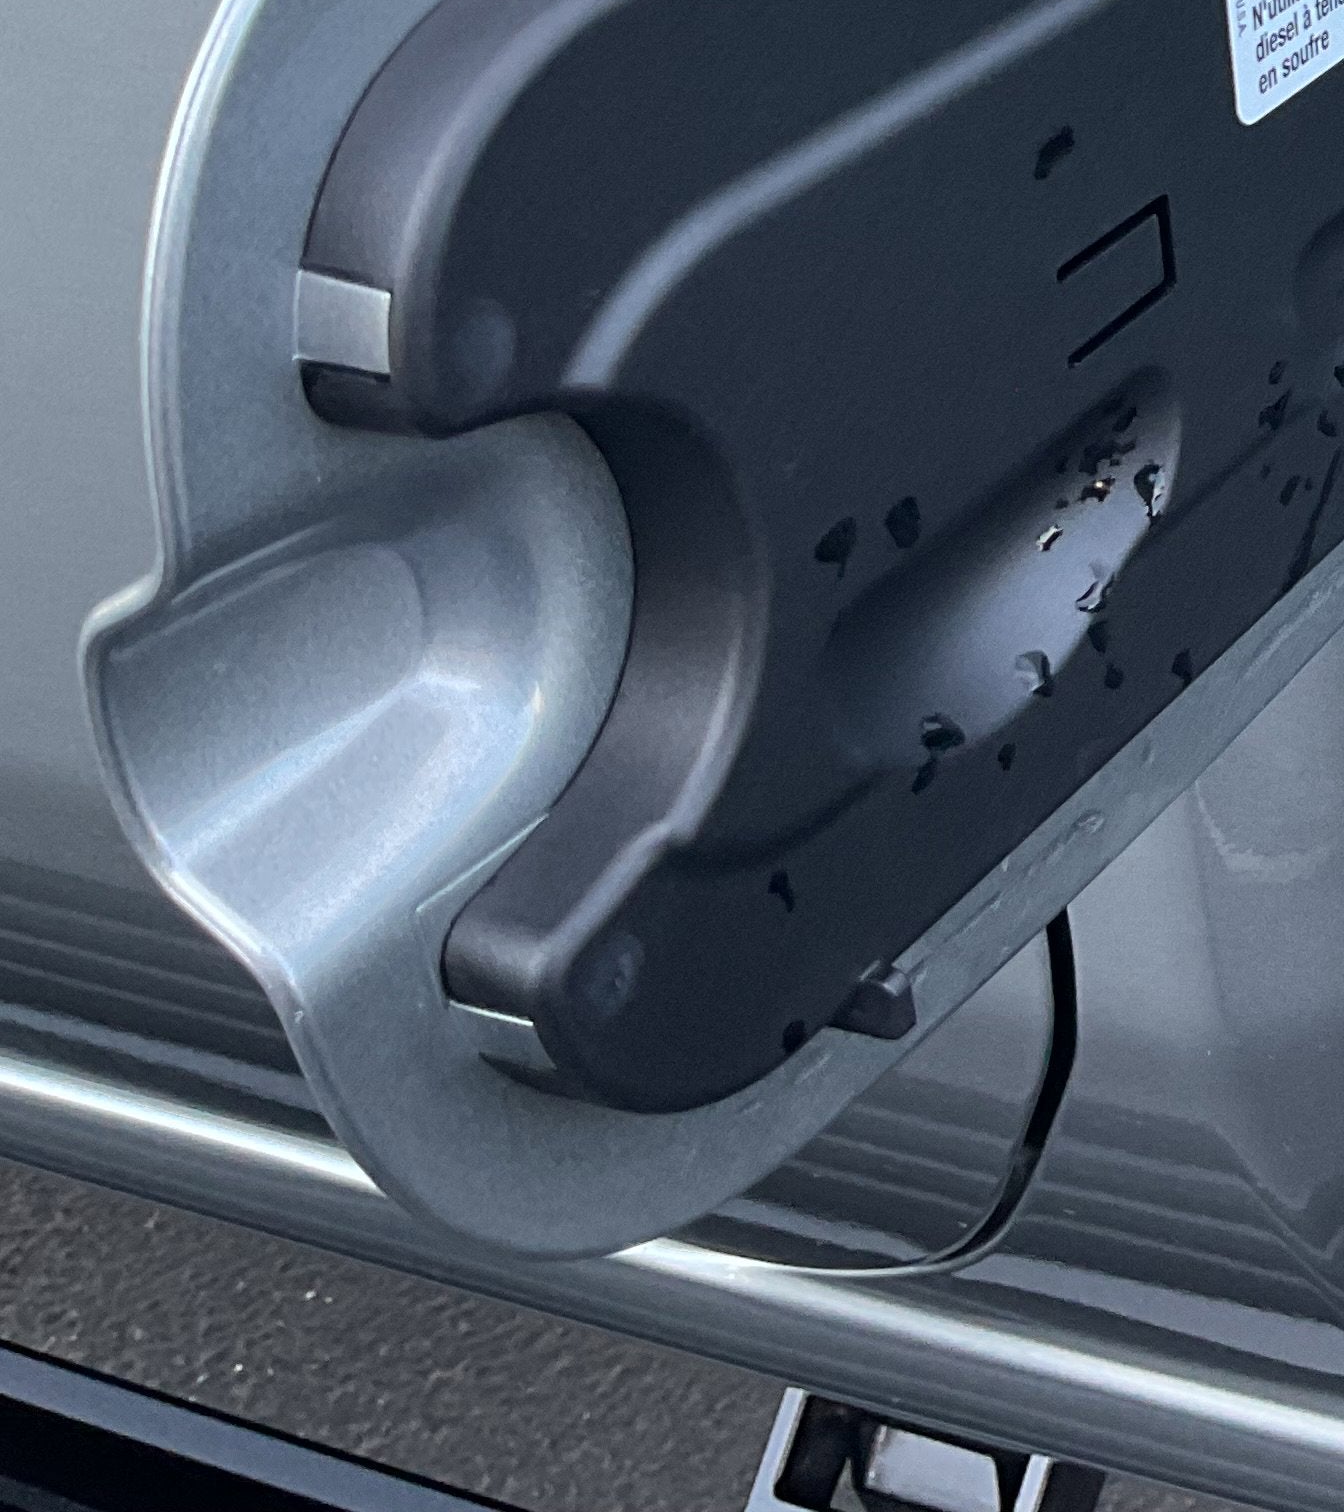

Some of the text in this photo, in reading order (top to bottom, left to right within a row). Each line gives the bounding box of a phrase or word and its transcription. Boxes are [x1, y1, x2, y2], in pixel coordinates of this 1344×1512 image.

[1255, 14, 1298, 63] diesel
[1303, 2, 1313, 28] à
[1259, 30, 1330, 94] en soufre
